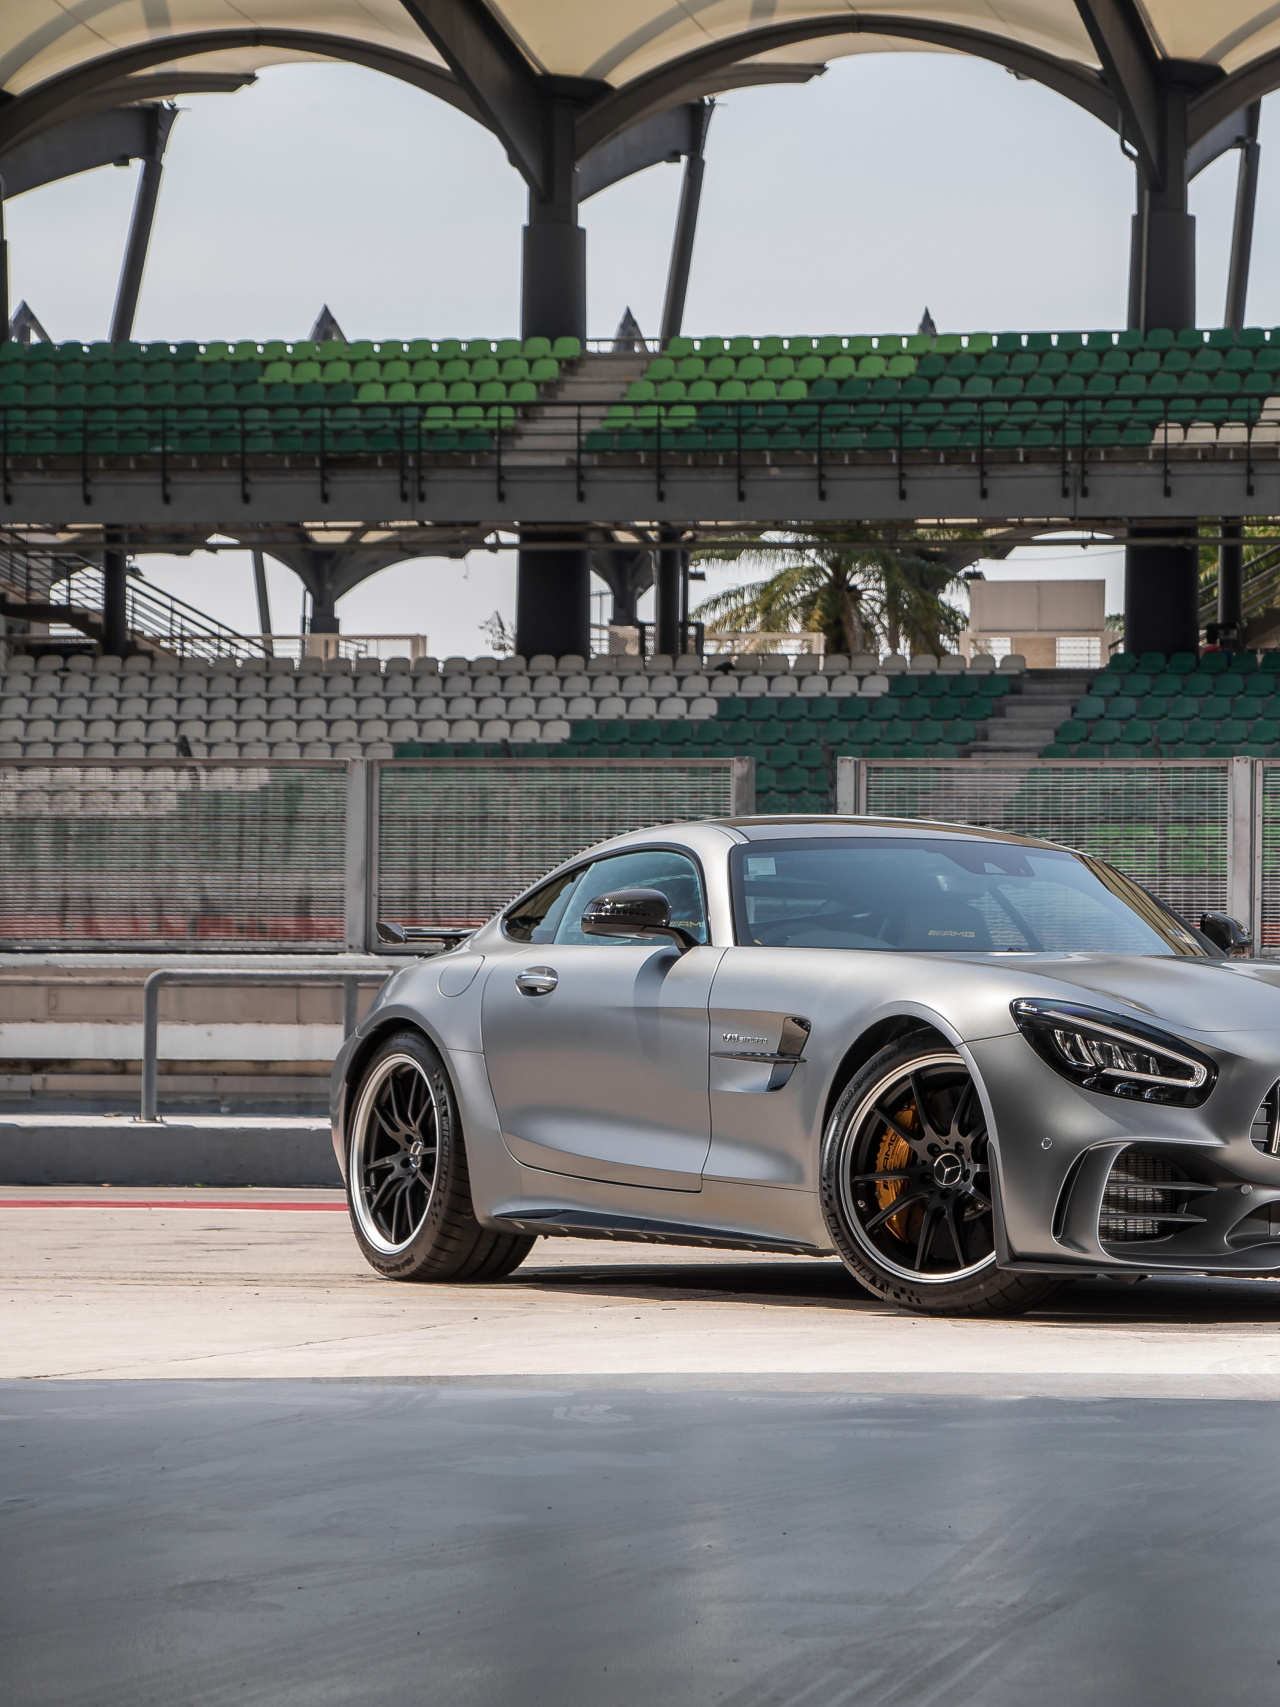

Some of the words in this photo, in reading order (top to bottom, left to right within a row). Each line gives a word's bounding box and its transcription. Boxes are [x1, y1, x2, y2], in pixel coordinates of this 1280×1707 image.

[942, 930, 976, 938] AMG
[437, 1116, 450, 1194] MICHELIN
[882, 1132, 898, 1171] AMG
[827, 1213, 875, 1282] MICHELIN
